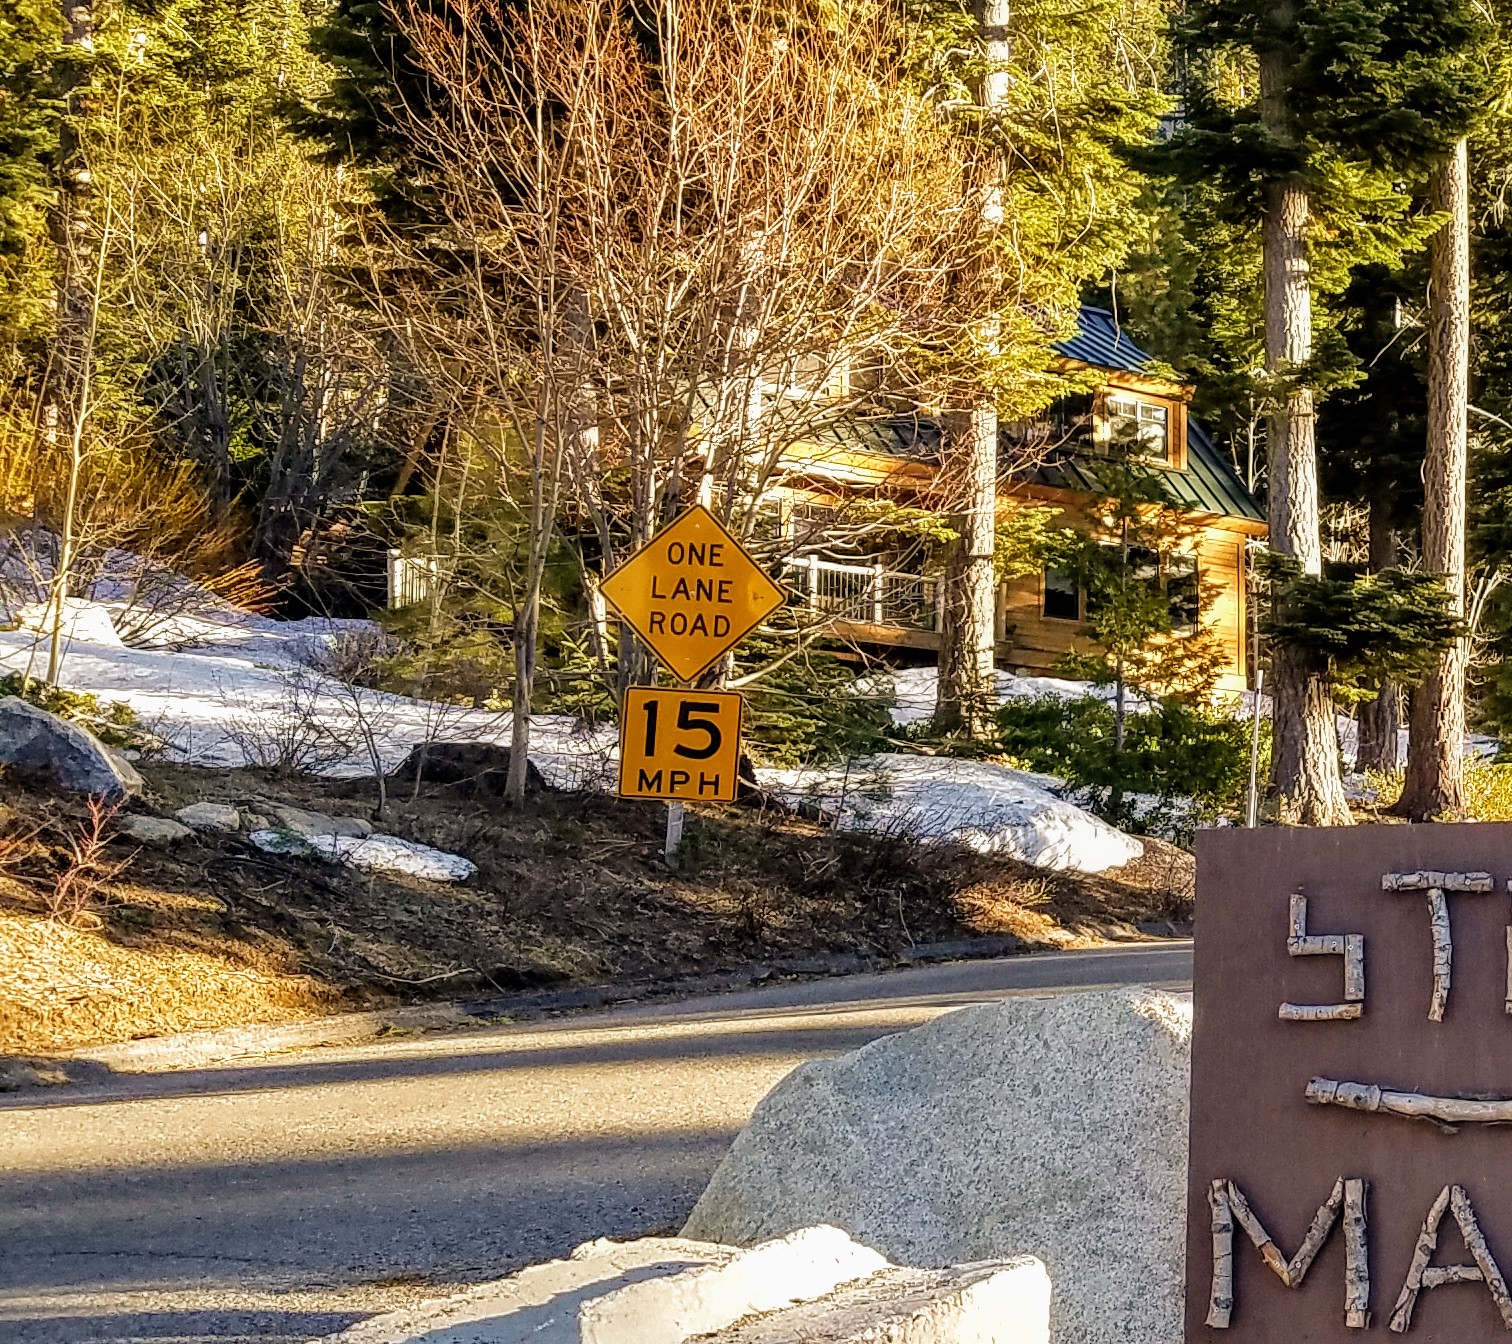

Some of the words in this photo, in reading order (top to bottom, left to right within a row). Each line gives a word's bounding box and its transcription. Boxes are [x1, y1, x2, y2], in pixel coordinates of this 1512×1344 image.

[667, 541, 725, 568] ONE
[651, 576, 734, 604] LANE
[649, 611, 731, 638] ROAD
[642, 699, 722, 760] 15
[637, 768, 720, 796] MPH
